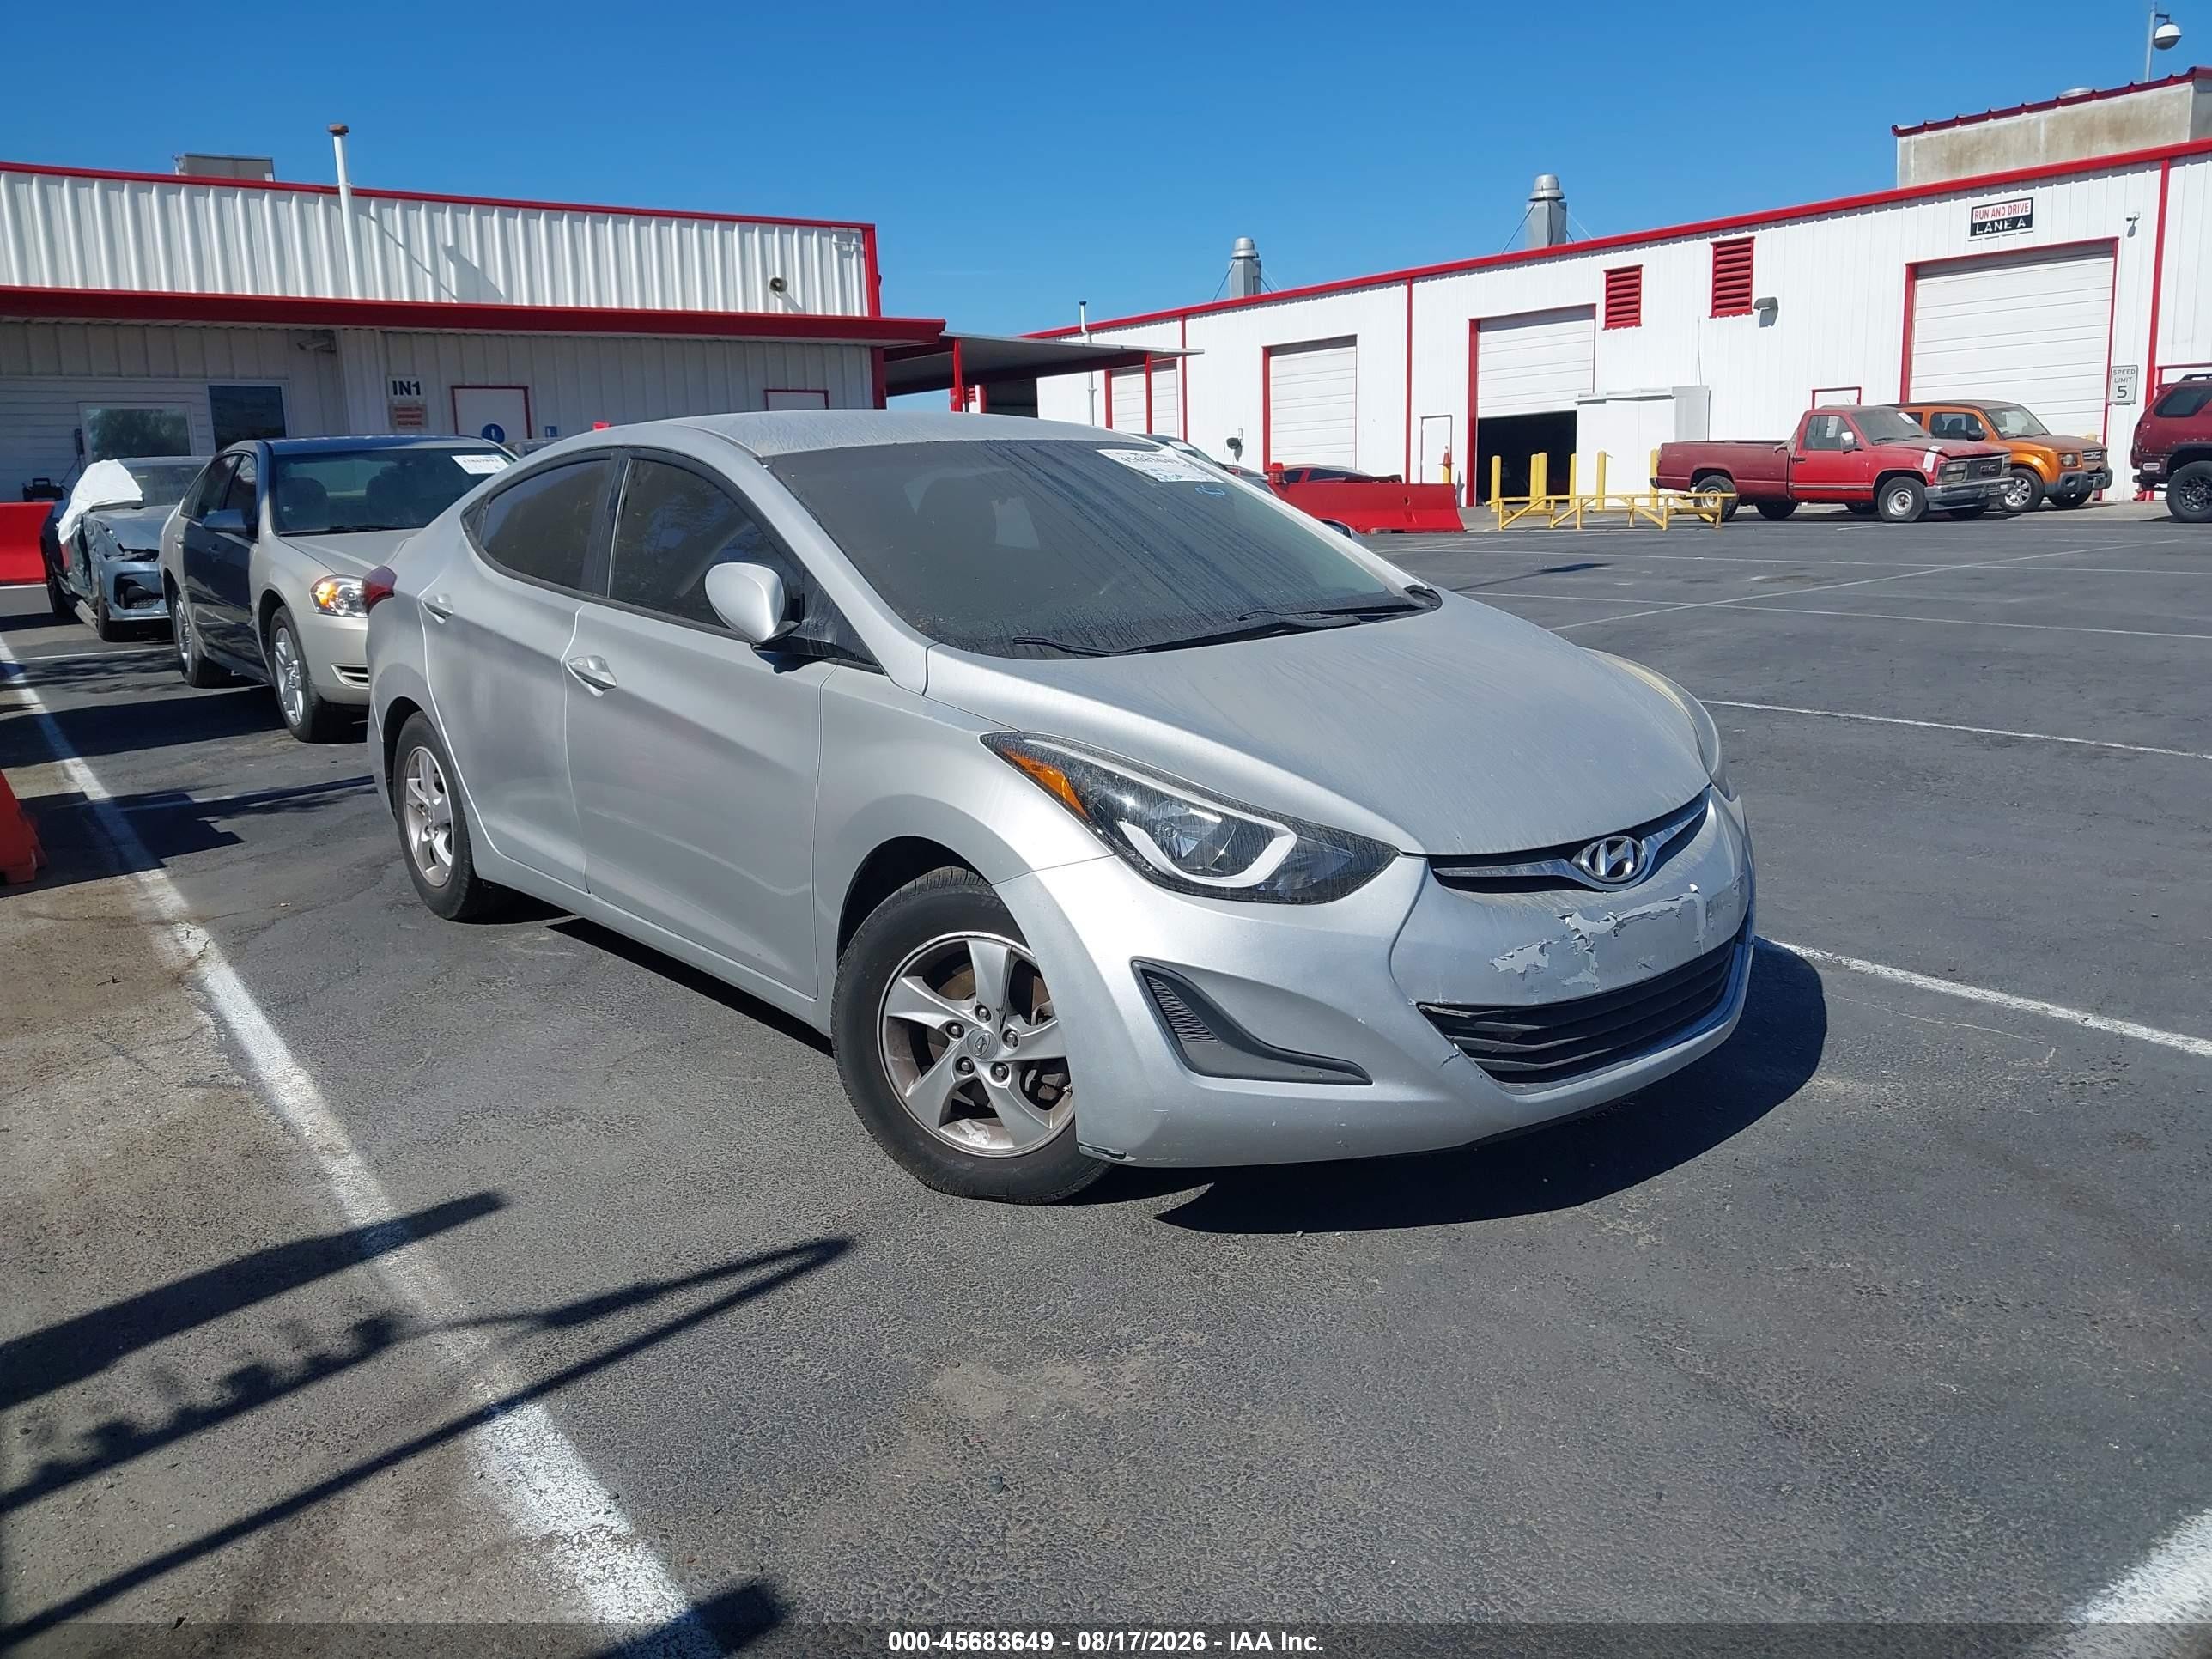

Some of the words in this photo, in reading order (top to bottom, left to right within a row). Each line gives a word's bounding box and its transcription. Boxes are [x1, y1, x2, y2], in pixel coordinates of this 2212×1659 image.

[1974, 208, 1990, 221] RUN
[1991, 206, 2006, 218] AND
[2008, 202, 2029, 216] DRIVE
[1976, 219, 2012, 234] LANE
[2016, 217, 2027, 228] A
[392, 380, 421, 396] IN1
[2117, 385, 2128, 398] 5
